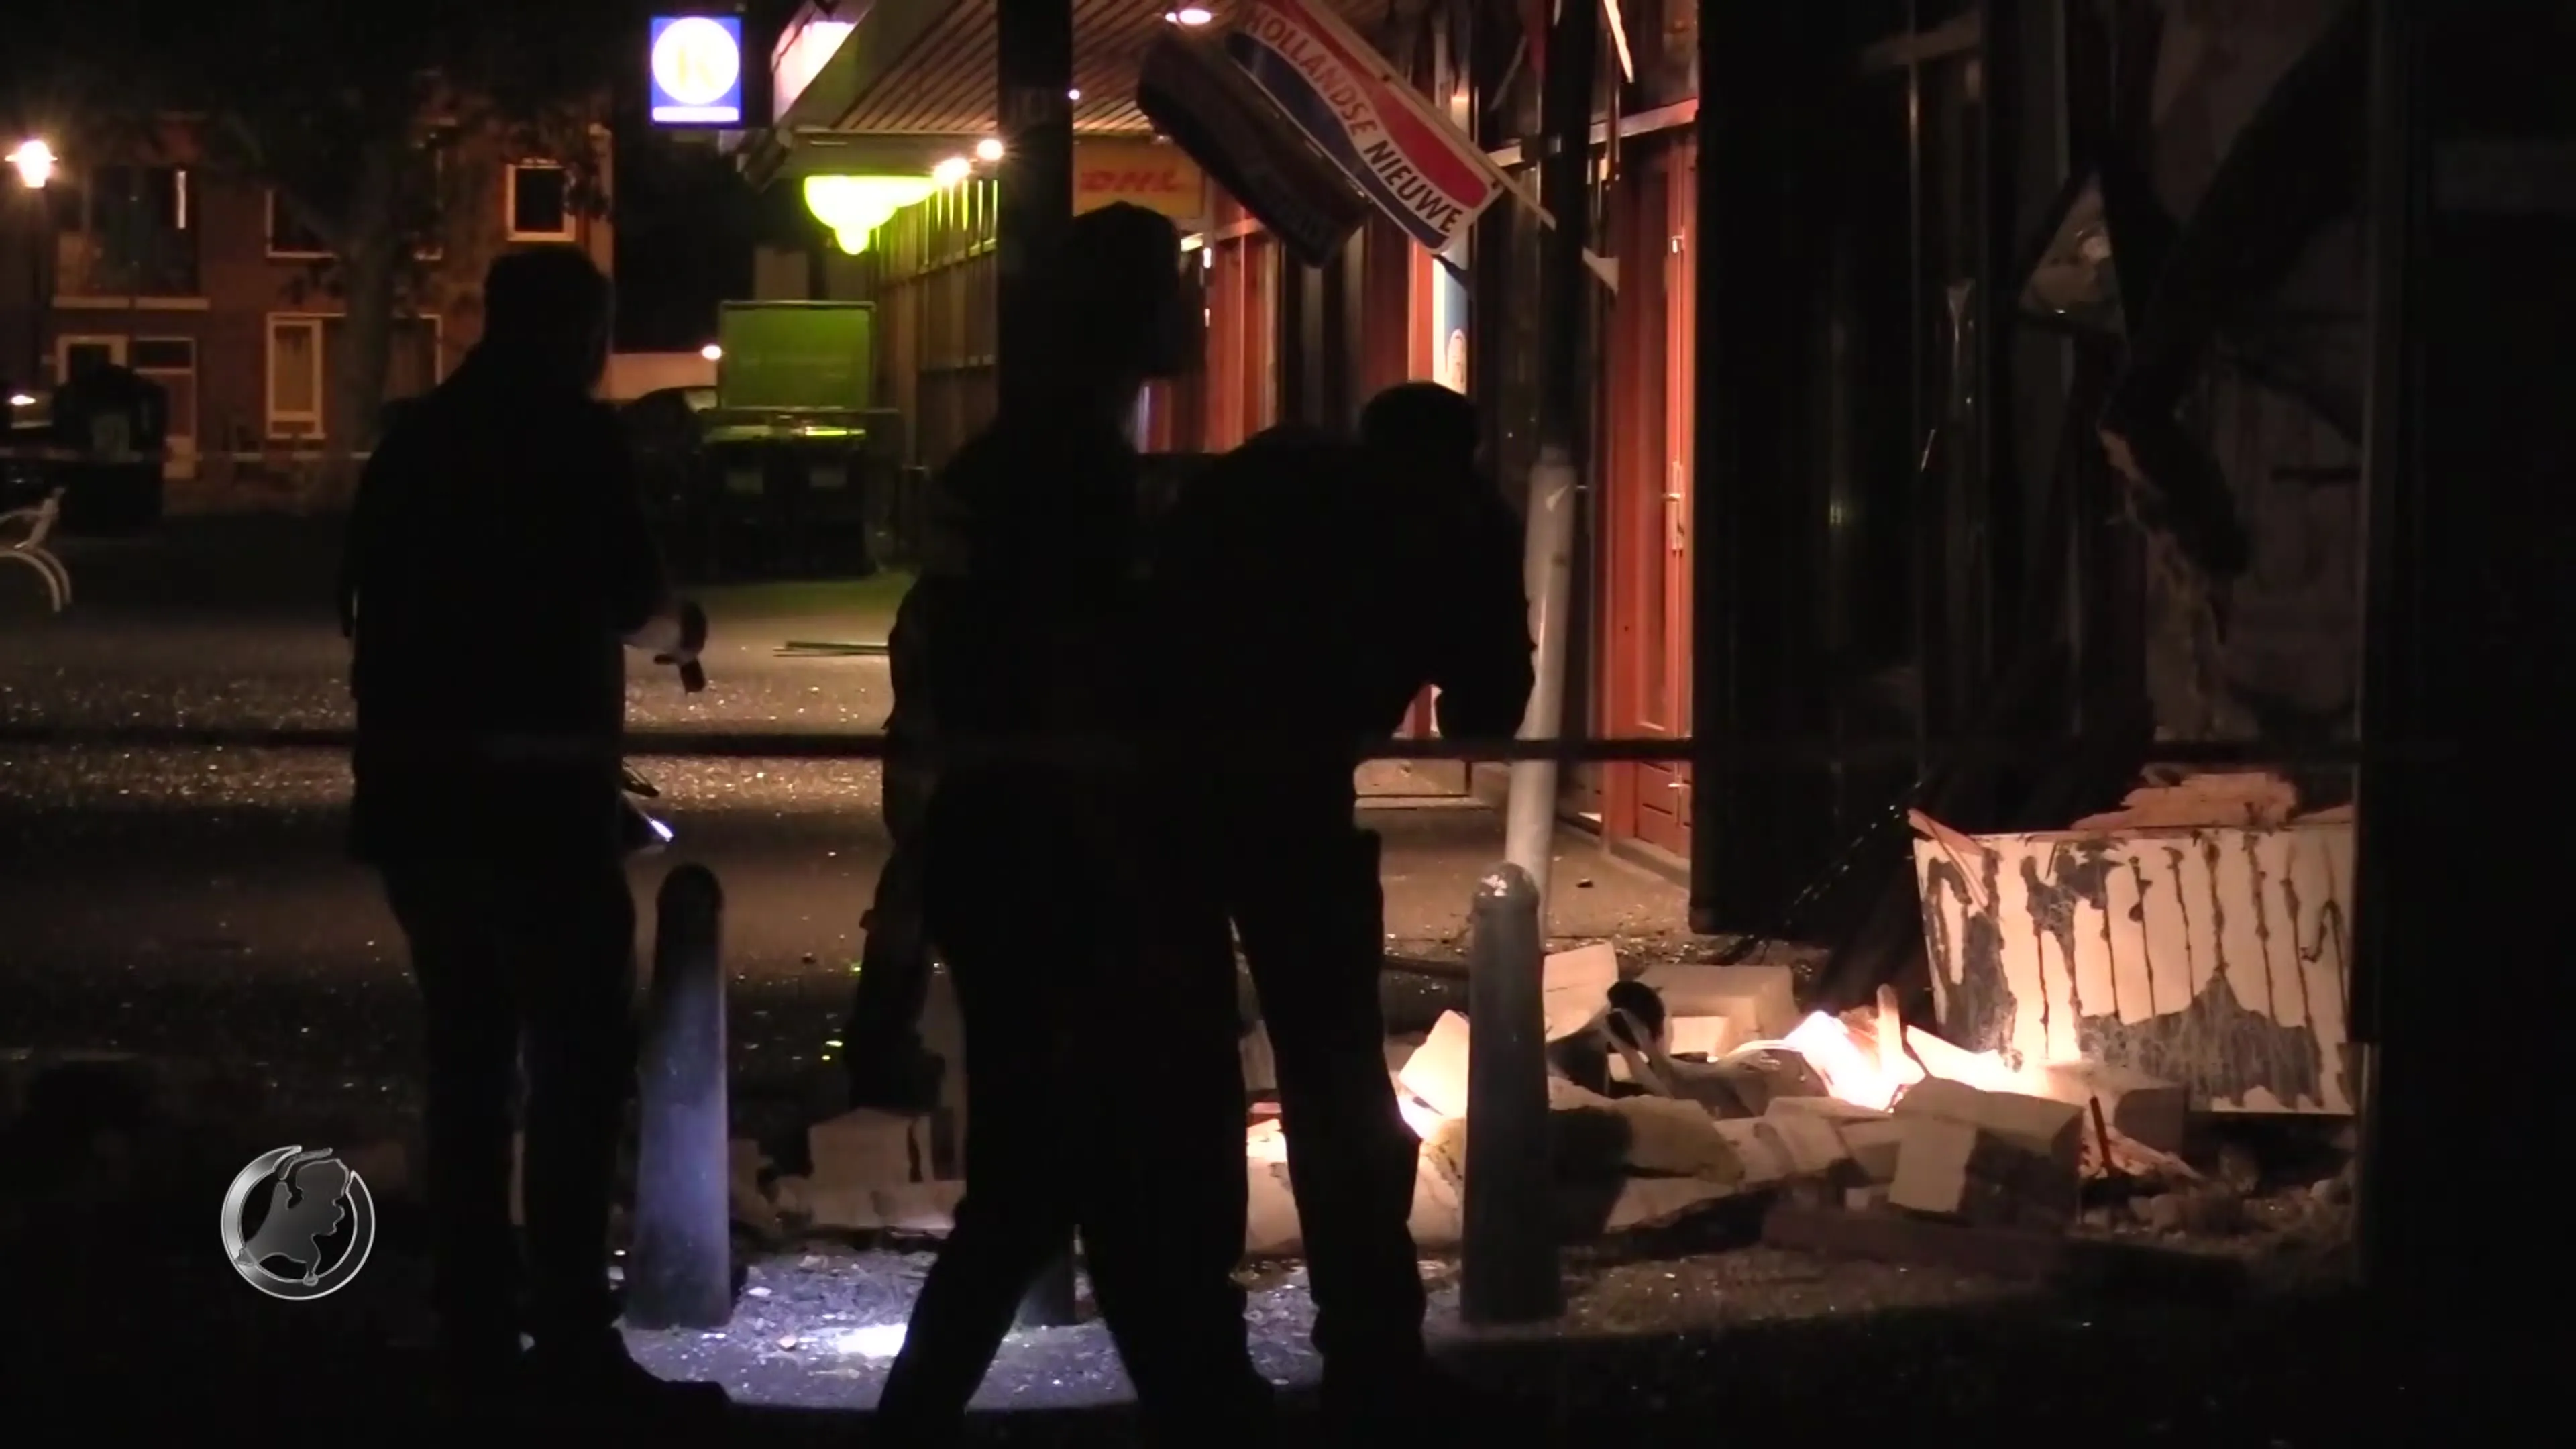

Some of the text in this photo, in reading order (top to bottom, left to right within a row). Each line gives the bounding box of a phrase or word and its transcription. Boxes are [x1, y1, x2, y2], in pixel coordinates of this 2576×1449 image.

[1081, 170, 1185, 193] DHL
[1243, 7, 1377, 136] HOLLANDSE
[1363, 140, 1463, 233] NIEUWE
